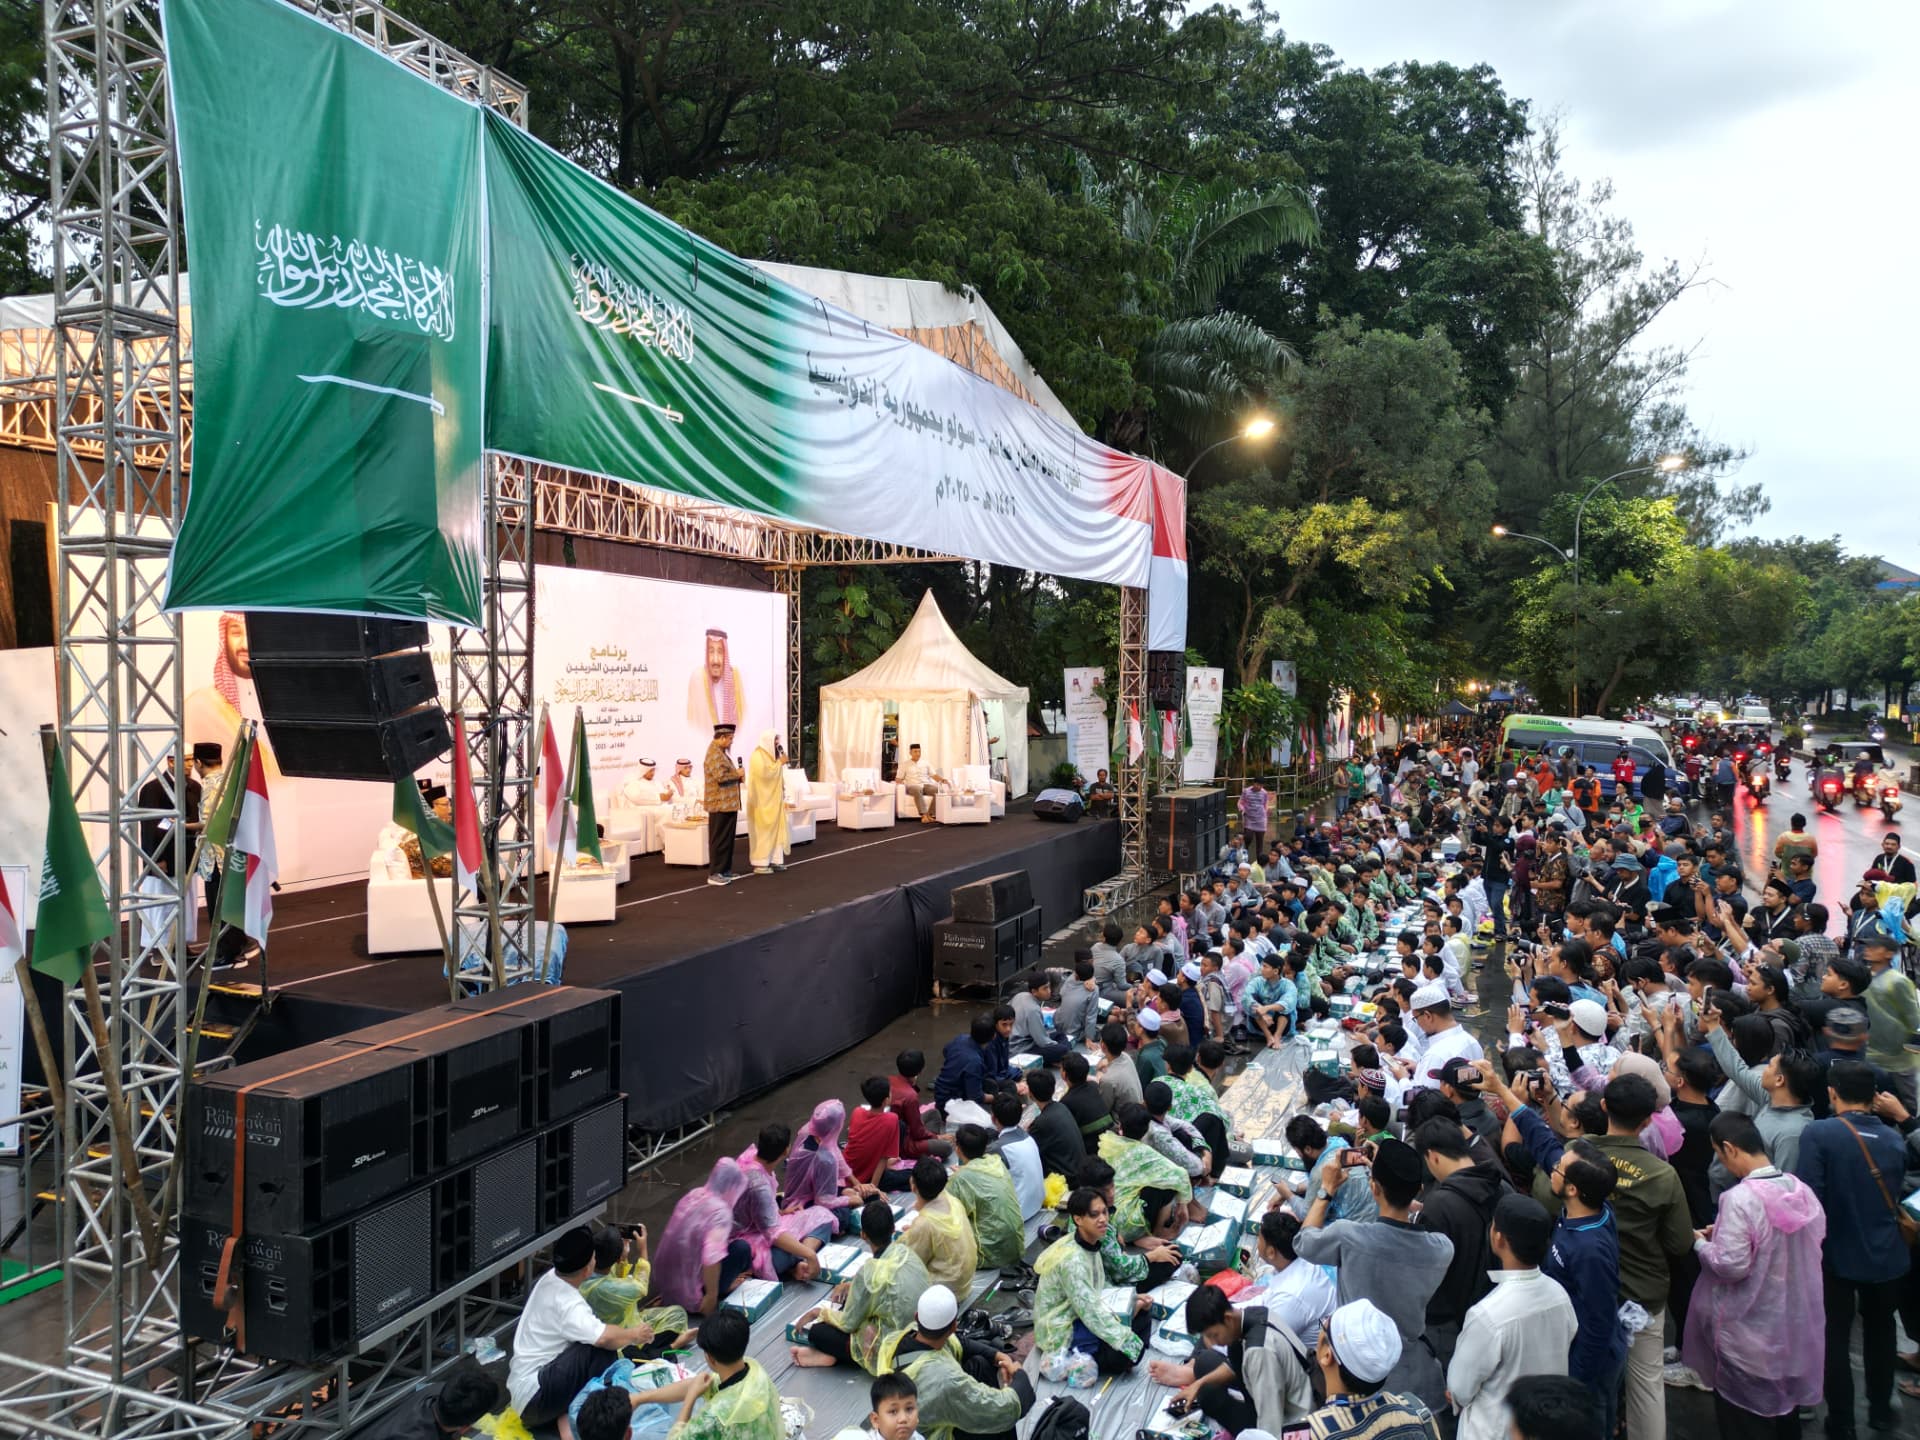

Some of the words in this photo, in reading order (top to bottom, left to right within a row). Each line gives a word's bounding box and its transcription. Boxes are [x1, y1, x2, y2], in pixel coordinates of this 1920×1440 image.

[883, 383, 944, 442] بجمهورية
[947, 412, 976, 451] سولو
[590, 644, 628, 661] برنامج
[1526, 719, 1563, 727] AMBULANCE
[472, 1106, 489, 1118] SPL
[352, 1153, 372, 1168] SPL
